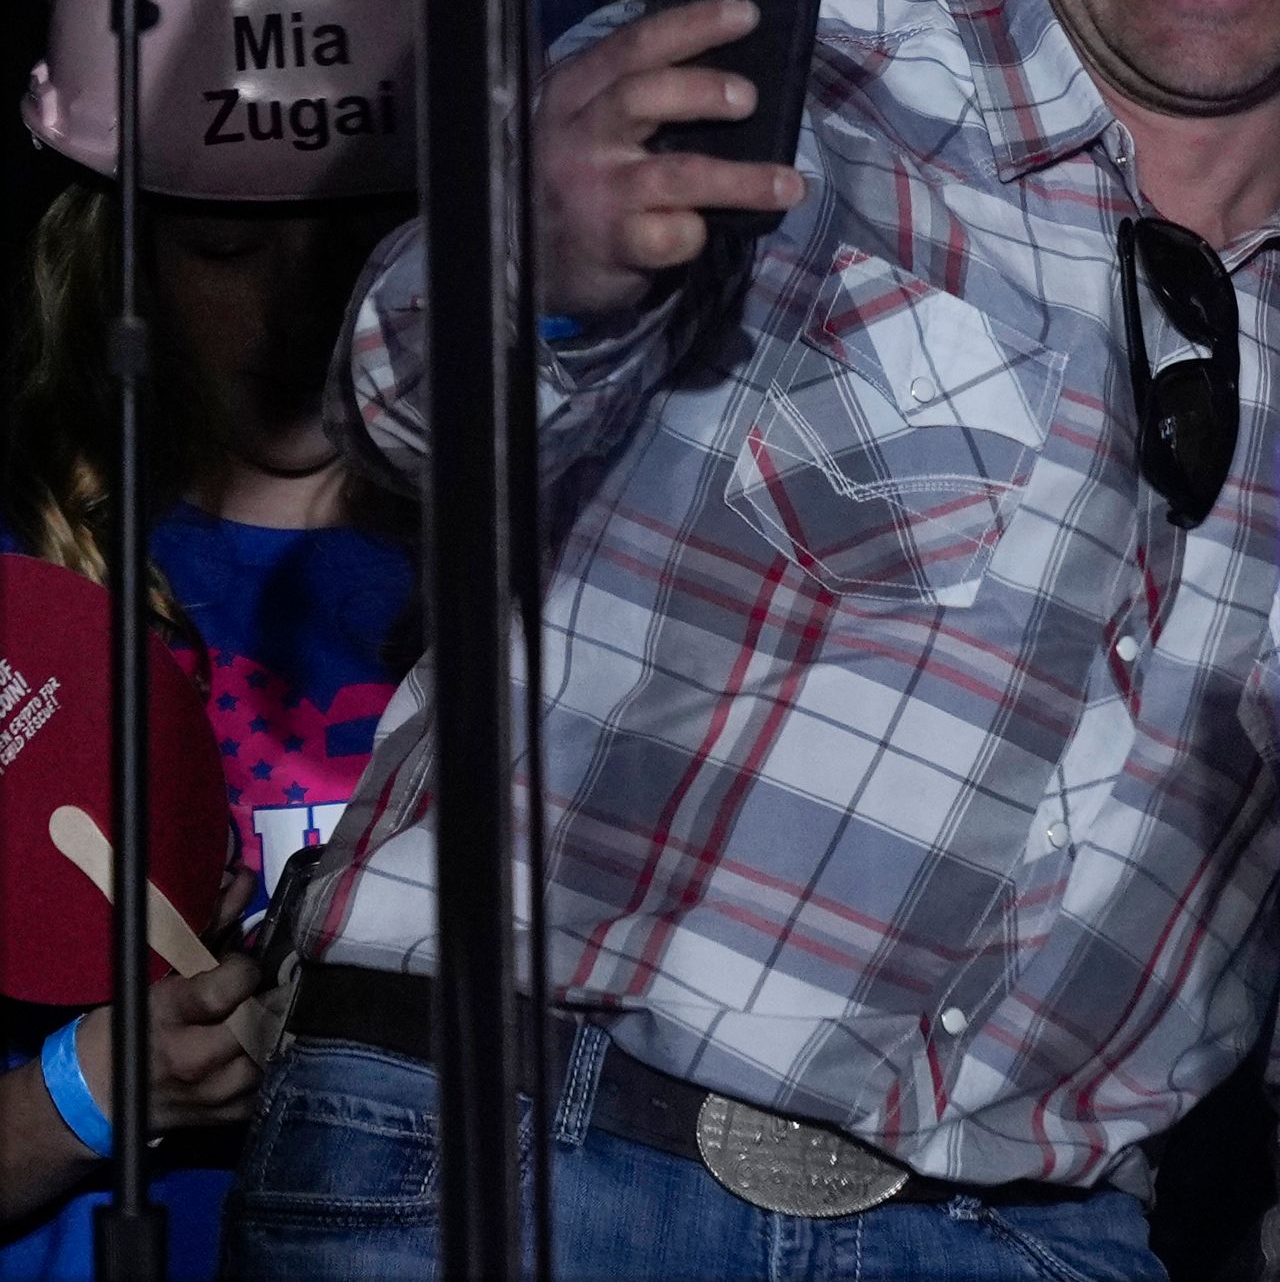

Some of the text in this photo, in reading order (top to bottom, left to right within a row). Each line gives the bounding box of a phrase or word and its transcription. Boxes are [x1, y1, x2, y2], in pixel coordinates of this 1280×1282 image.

[233, 11, 351, 72] Mia
[203, 80, 397, 152] Zugai
[39, 677, 61, 701] FOR
